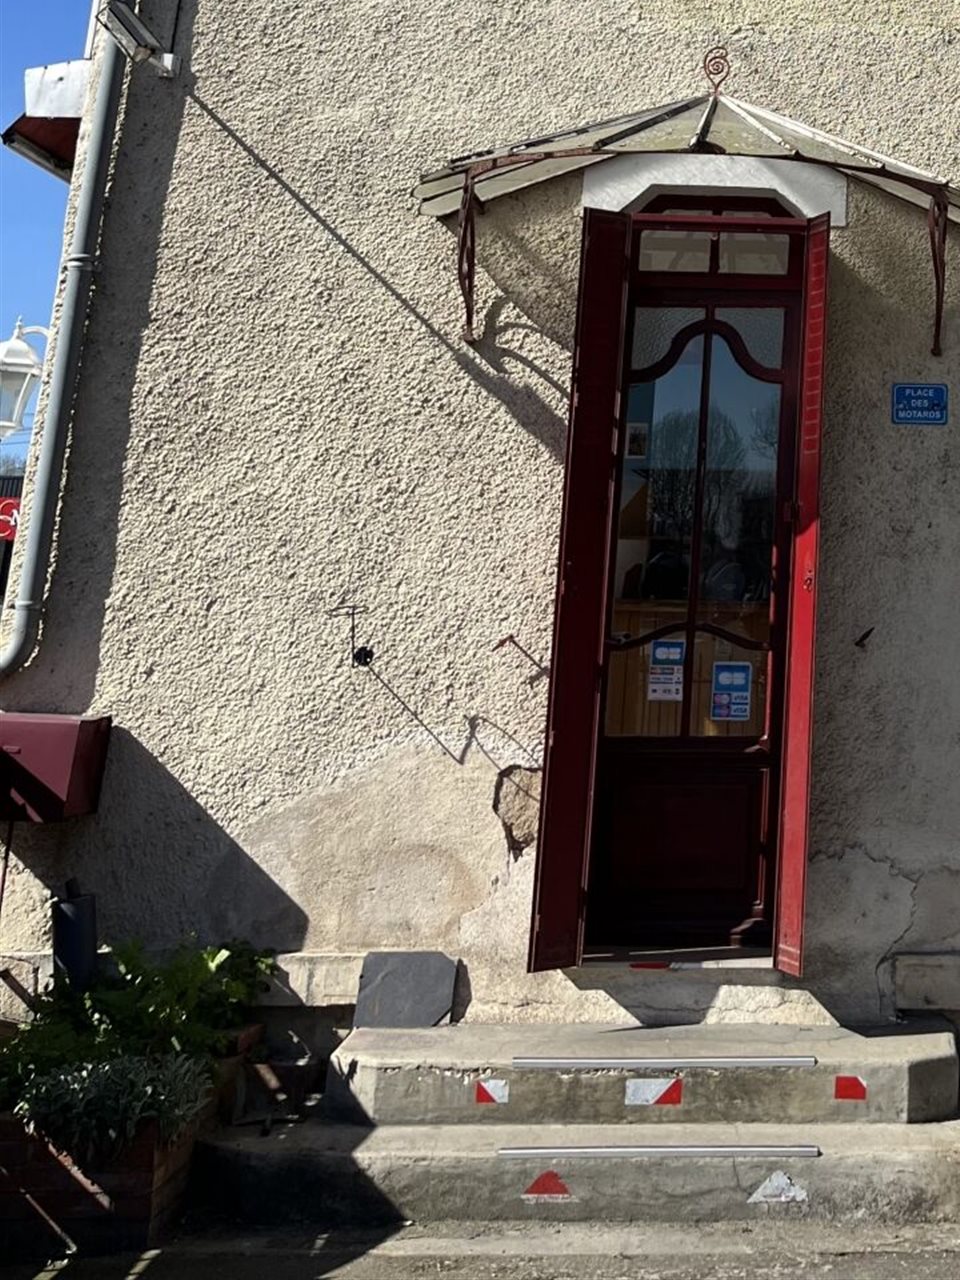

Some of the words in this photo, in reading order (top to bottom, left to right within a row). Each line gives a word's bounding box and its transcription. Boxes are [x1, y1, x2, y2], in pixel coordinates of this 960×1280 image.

[905, 389, 934, 397] PLACE
[911, 399, 929, 407] DES
[898, 410, 941, 419] MOTARDS
